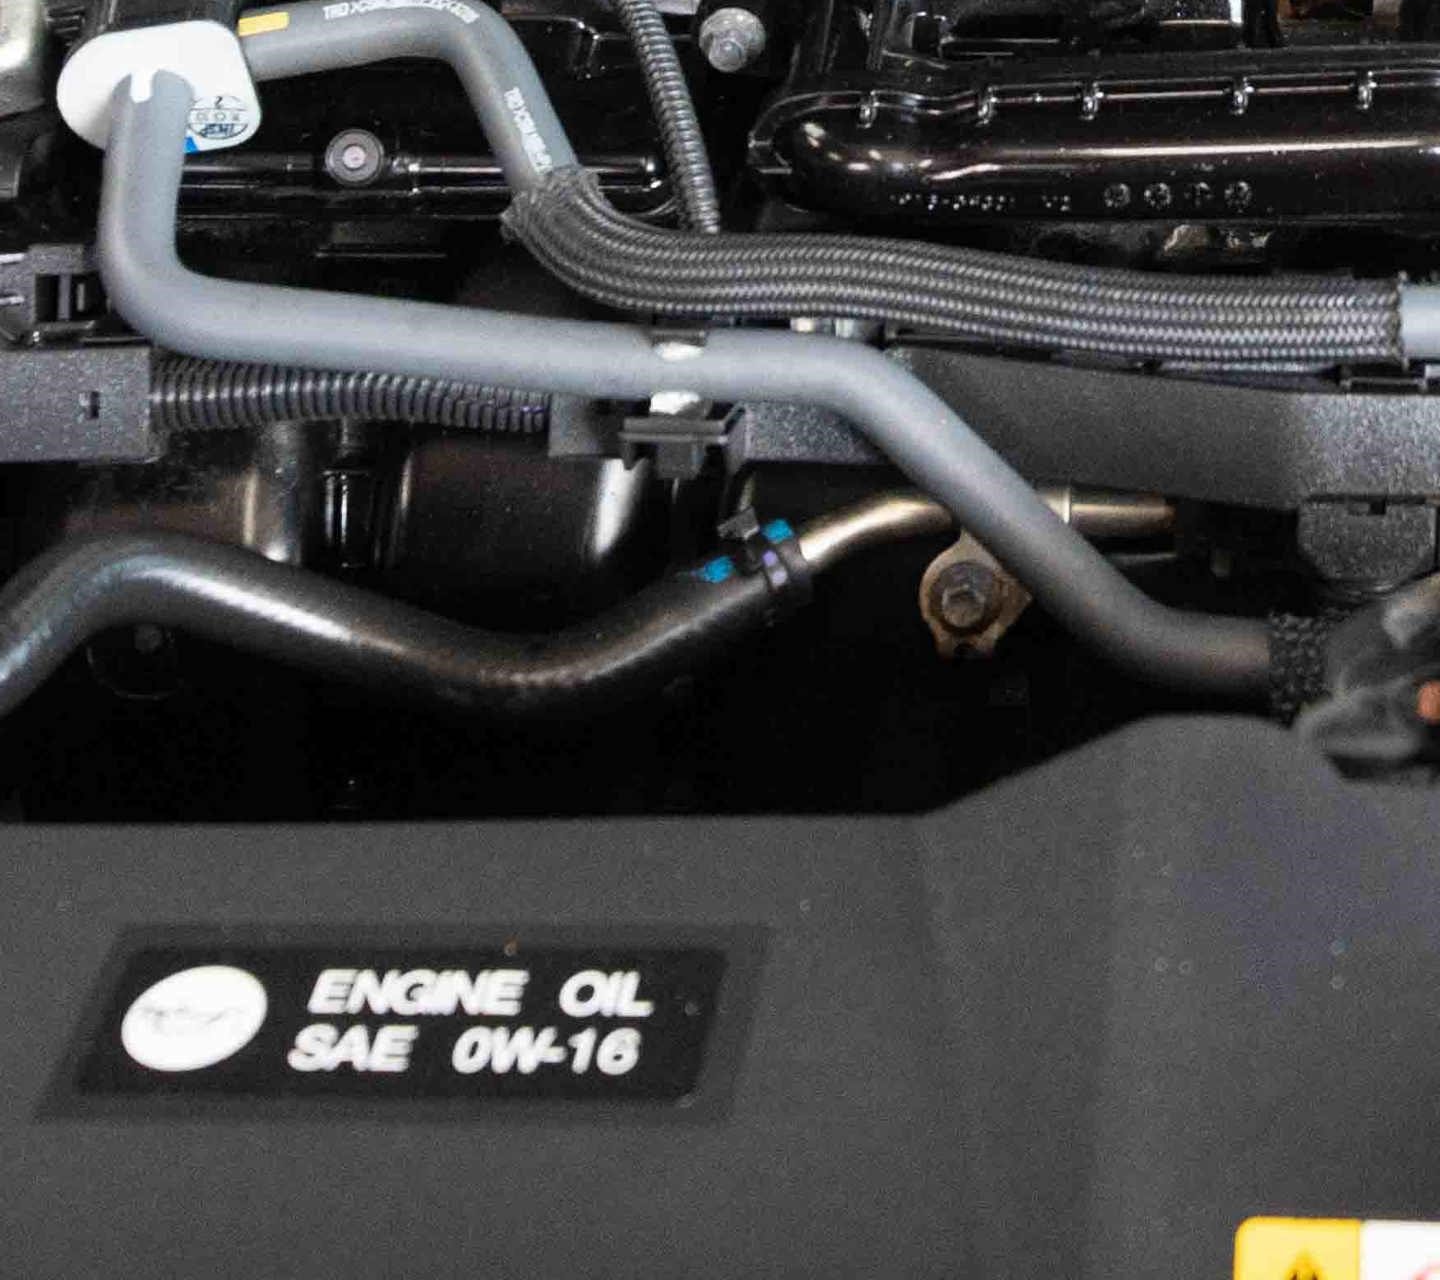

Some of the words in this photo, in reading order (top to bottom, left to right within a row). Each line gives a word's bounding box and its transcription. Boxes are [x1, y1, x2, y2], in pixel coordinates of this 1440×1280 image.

[308, 970, 528, 1015] ENGINE
[559, 970, 653, 1018] OIL
[287, 1024, 418, 1072] SAE
[452, 1027, 640, 1075] 0W-16
